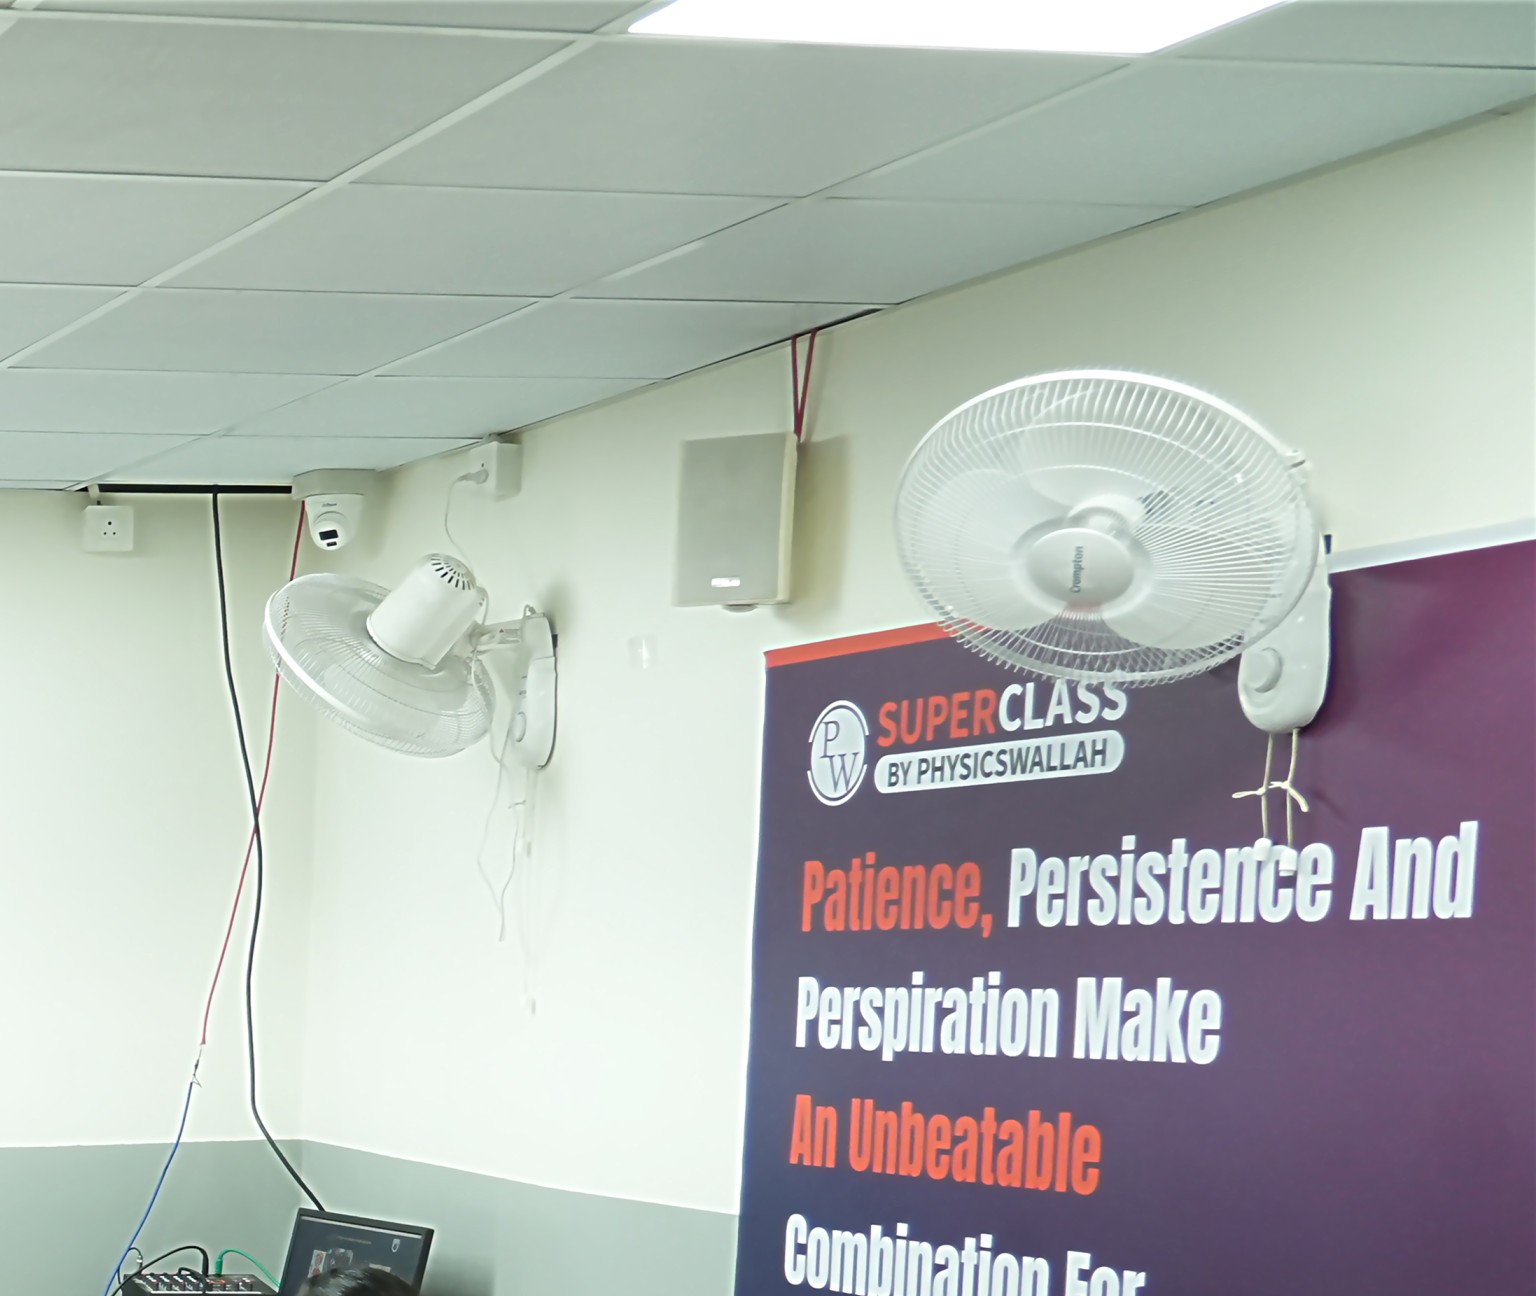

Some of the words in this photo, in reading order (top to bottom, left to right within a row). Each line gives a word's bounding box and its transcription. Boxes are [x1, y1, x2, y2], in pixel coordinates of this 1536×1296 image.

[1069, 546, 1085, 593] Crompton
[877, 678, 1128, 747] SUPERCLASS
[887, 761, 912, 787] BY
[917, 738, 1107, 785] PHYSICSWALLAH
[801, 852, 992, 938] Patience,
[1007, 834, 1333, 928] Persistence
[1349, 821, 1479, 922] And
[795, 971, 1058, 1062] Perspiration
[1073, 976, 1222, 1065] Make
[789, 1094, 837, 1169] An
[848, 1098, 1102, 1196] Unbeatable
